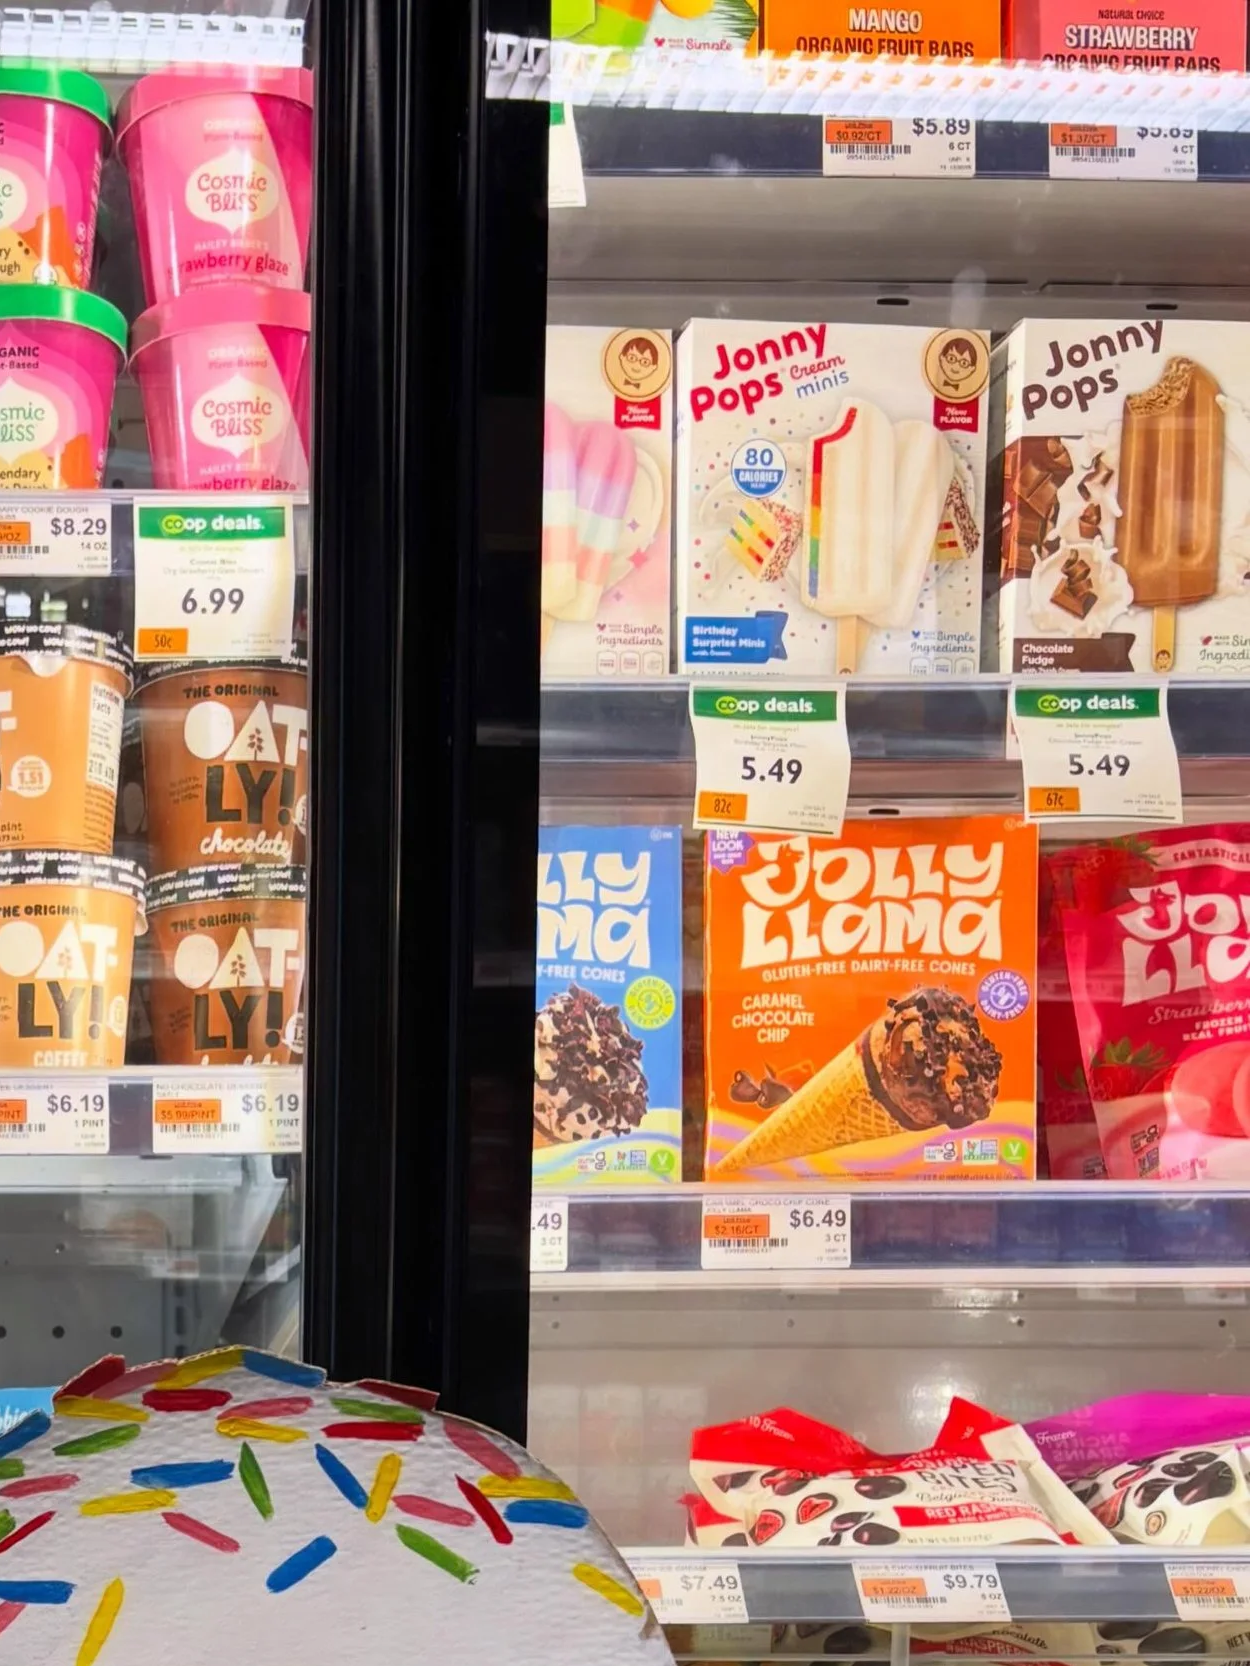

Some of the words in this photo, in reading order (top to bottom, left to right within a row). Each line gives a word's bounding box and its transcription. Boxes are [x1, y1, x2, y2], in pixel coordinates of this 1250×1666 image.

[848, 7, 923, 33] MANGO
[1064, 25, 1199, 50] STRAWBERRY
[877, 38, 925, 57] FRUIT
[929, 40, 974, 58] BARS
[912, 117, 971, 136] $5.89
[713, 323, 828, 380] Jonny
[1046, 319, 1164, 378] Jonny
[795, 371, 851, 398] minis
[1021, 367, 1118, 421] Pops
[202, 396, 273, 417] Cosmic
[690, 372, 784, 422] Pops
[745, 448, 773, 467] 80
[738, 470, 780, 484] CALORIES
[50, 517, 107, 537] $8.29
[181, 588, 245, 615] 6.99
[692, 626, 738, 638] Birthday
[692, 637, 737, 649] Surprise
[1021, 643, 1074, 655] Chocolate
[1021, 655, 1055, 666] Fudge
[182, 684, 212, 699] THE
[214, 683, 280, 697] ORIGINAL
[741, 755, 803, 785] 5.49
[1068, 753, 1131, 778] 5.49
[205, 763, 296, 827] LY!
[199, 826, 292, 857] chocolate
[712, 840, 744, 851] LOOK
[170, 917, 198, 933] THE
[198, 911, 260, 928] ORIGINAL
[580, 966, 626, 984] CONES
[762, 960, 847, 984] GLUTEN-FREE
[850, 959, 925, 974] DAIRY-FREE
[928, 961, 977, 977] CONES
[17, 980, 105, 1040] LY!
[741, 993, 805, 1011] CARAMEL
[194, 990, 285, 1050] LY!
[732, 1011, 815, 1029] CHOCOLATE
[757, 1027, 790, 1044] CHIP
[1182, 1027, 1214, 1042] REAL
[46, 1094, 105, 1114] $6.19
[241, 1093, 300, 1113] $6.19
[790, 1209, 848, 1230] $6.49
[924, 1507, 959, 1520] RED
[679, 1574, 739, 1592] $7.49
[944, 1573, 999, 1591] $9.79
